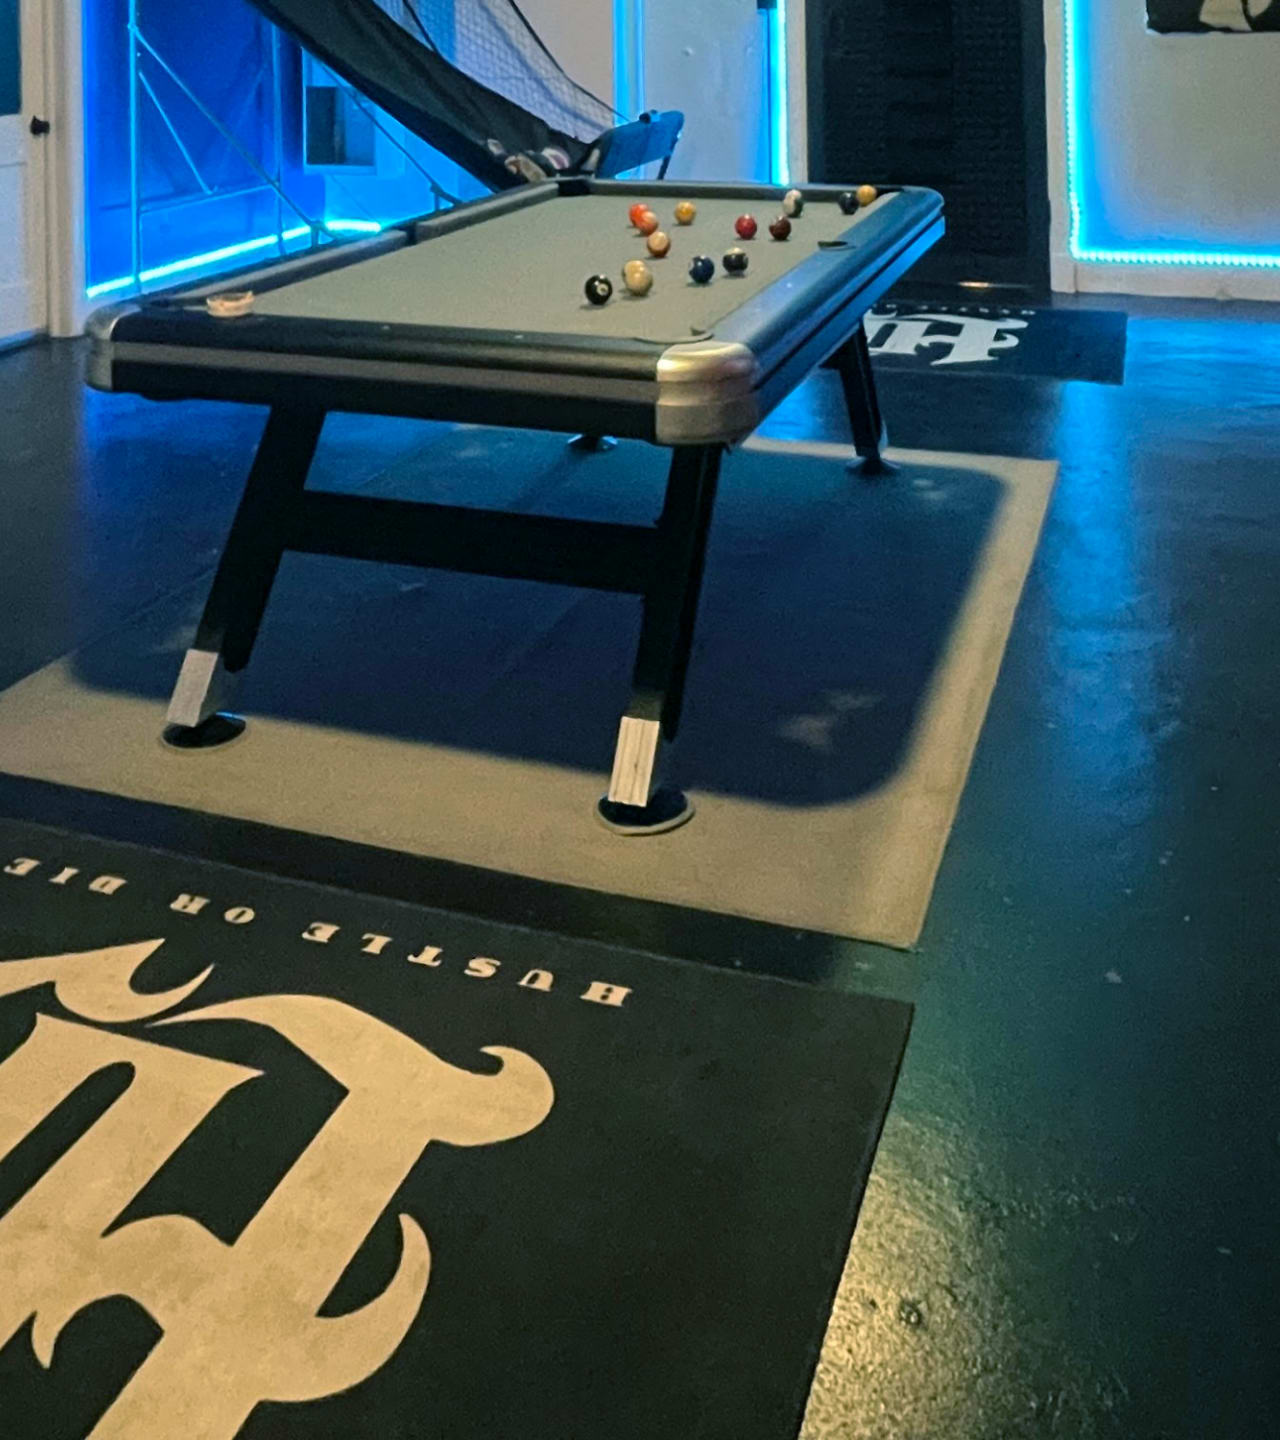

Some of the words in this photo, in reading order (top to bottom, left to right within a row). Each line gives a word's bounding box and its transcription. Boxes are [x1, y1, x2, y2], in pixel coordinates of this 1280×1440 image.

[3, 858, 127, 895] DIE
[170, 893, 256, 925] OR
[302, 922, 632, 1007] HUSTLE
